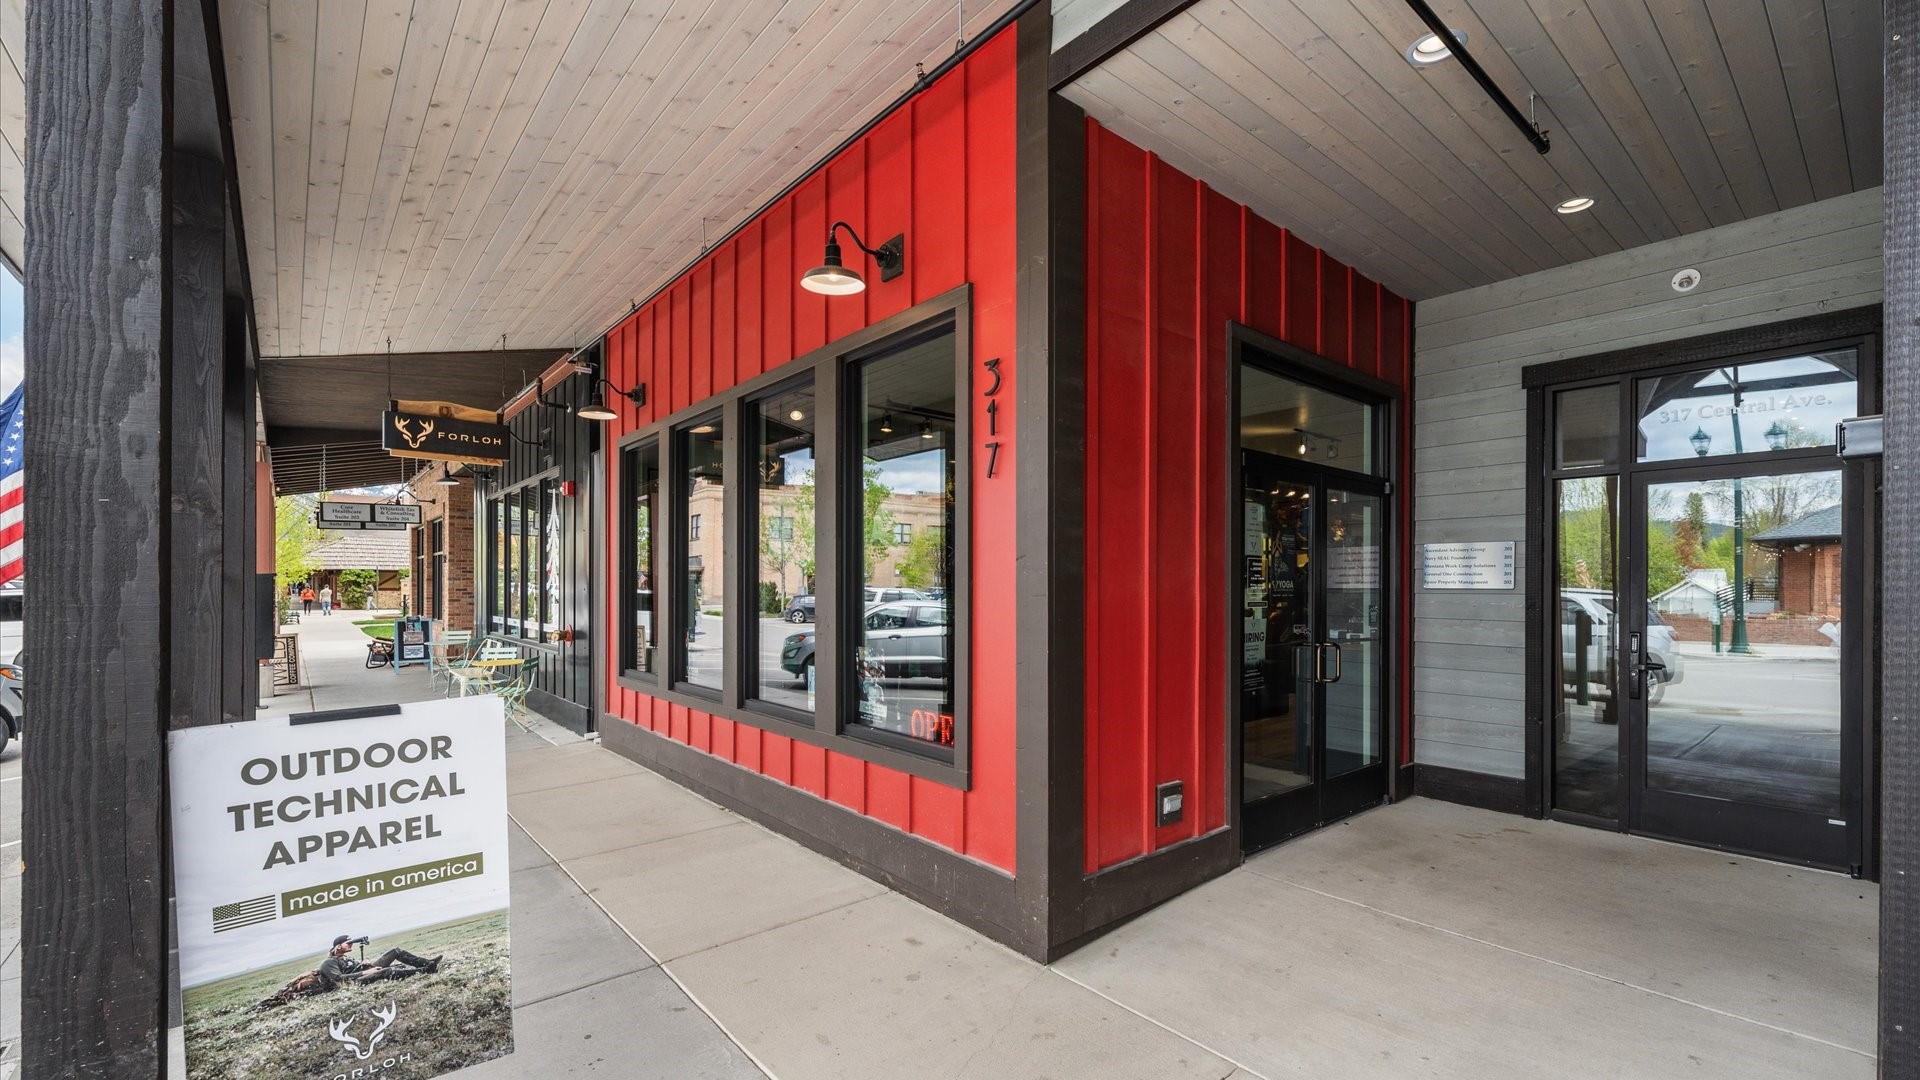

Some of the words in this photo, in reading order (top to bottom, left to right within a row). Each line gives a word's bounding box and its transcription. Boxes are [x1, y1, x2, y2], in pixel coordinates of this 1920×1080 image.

[984, 358, 1001, 479] 317
[1659, 407, 1692, 425] 317
[1699, 395, 1776, 419] Central
[1782, 393, 1833, 410] Ave.
[438, 431, 502, 446] FORLOH
[1279, 580, 1294, 589] YOGA
[1244, 632, 1265, 643] IRING
[289, 663, 297, 684] COFFEE
[240, 735, 453, 786] OUTDOOR
[227, 772, 466, 832] TECHNICAL
[262, 814, 442, 870] APPAREL
[289, 882, 360, 911] made
[366, 877, 385, 900] in
[391, 858, 478, 888] america
[333, 1053, 411, 1080] ORLOH
